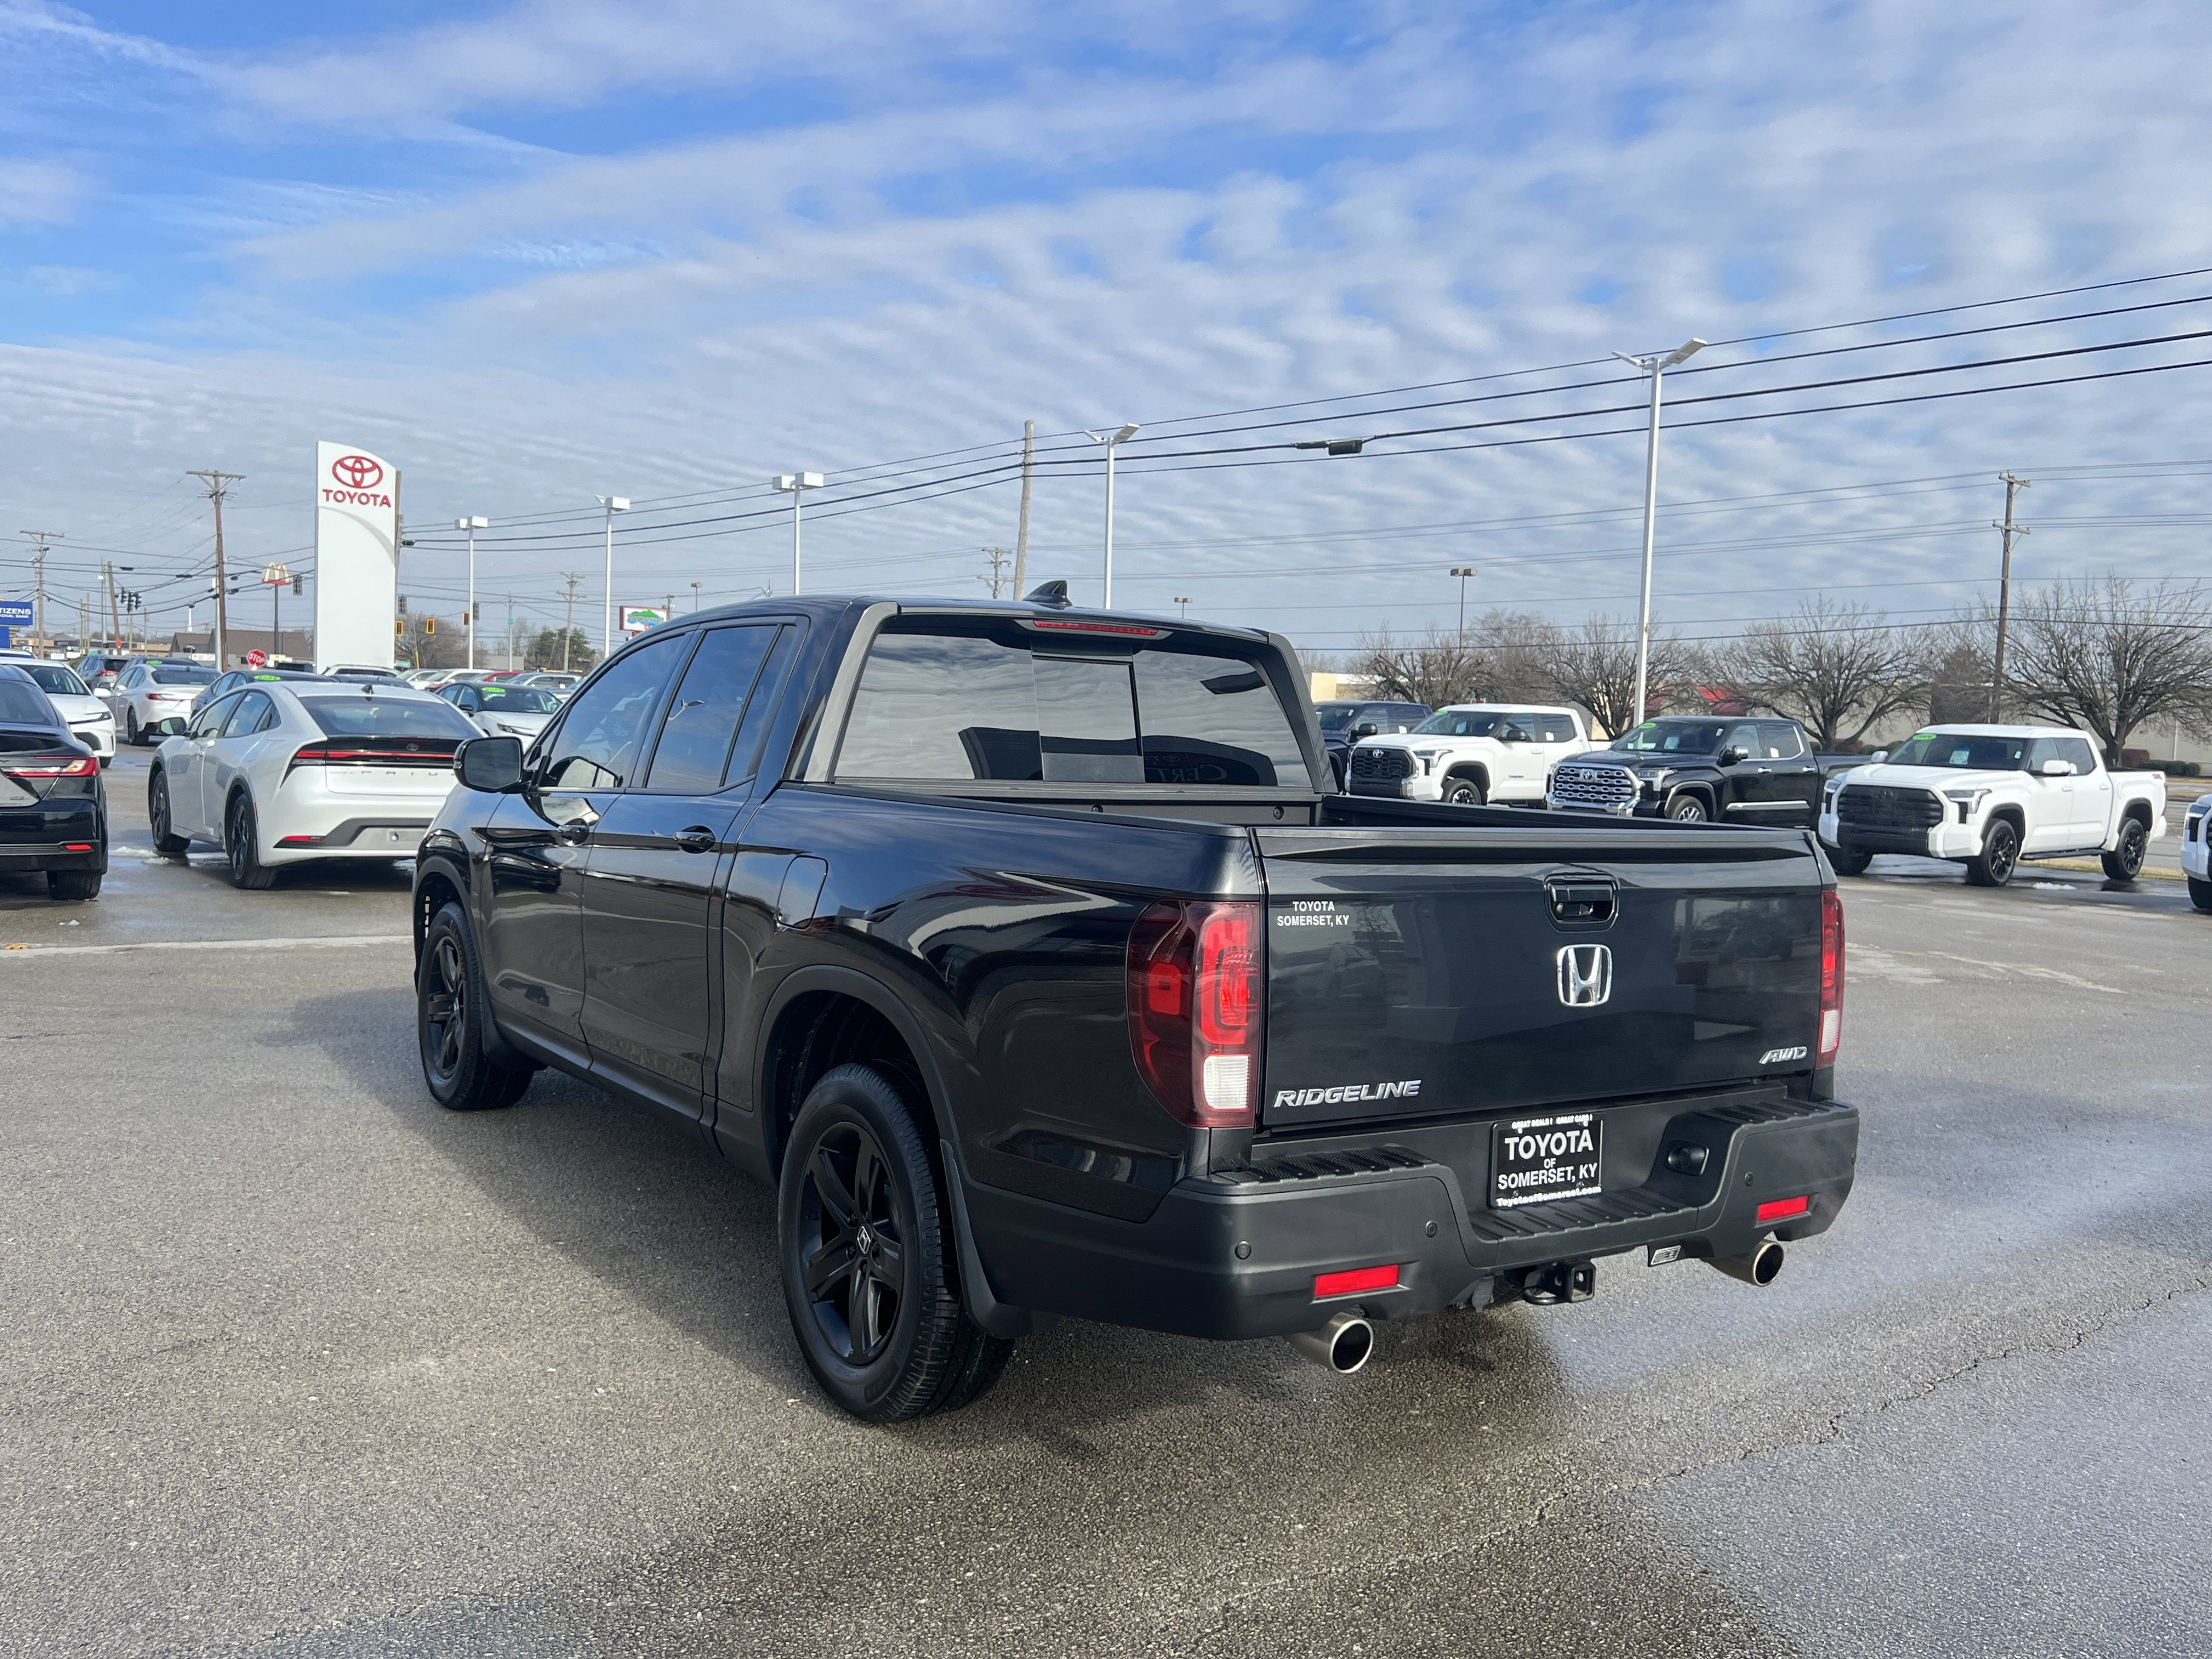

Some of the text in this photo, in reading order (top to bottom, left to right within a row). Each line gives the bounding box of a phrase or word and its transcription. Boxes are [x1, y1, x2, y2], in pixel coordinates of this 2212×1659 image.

[322, 489, 392, 508] TOYOTA
[248, 653, 266, 664] STOP
[1293, 901, 1335, 912] TOYOTA
[1277, 915, 1350, 927] SOMERSET, KY
[1759, 1046, 1807, 1064] AWD
[1273, 1080, 1421, 1108] RIDGELINE
[1511, 1120, 1531, 1129] GREAT
[1556, 1115, 1575, 1125] GREAT
[1505, 1128, 1594, 1160] TOYOTA
[1544, 1158, 1556, 1169] OF
[1498, 1163, 1598, 1190] SOMERSET, KY
[1496, 1186, 1601, 1207] ToyotaofSomerset.com
